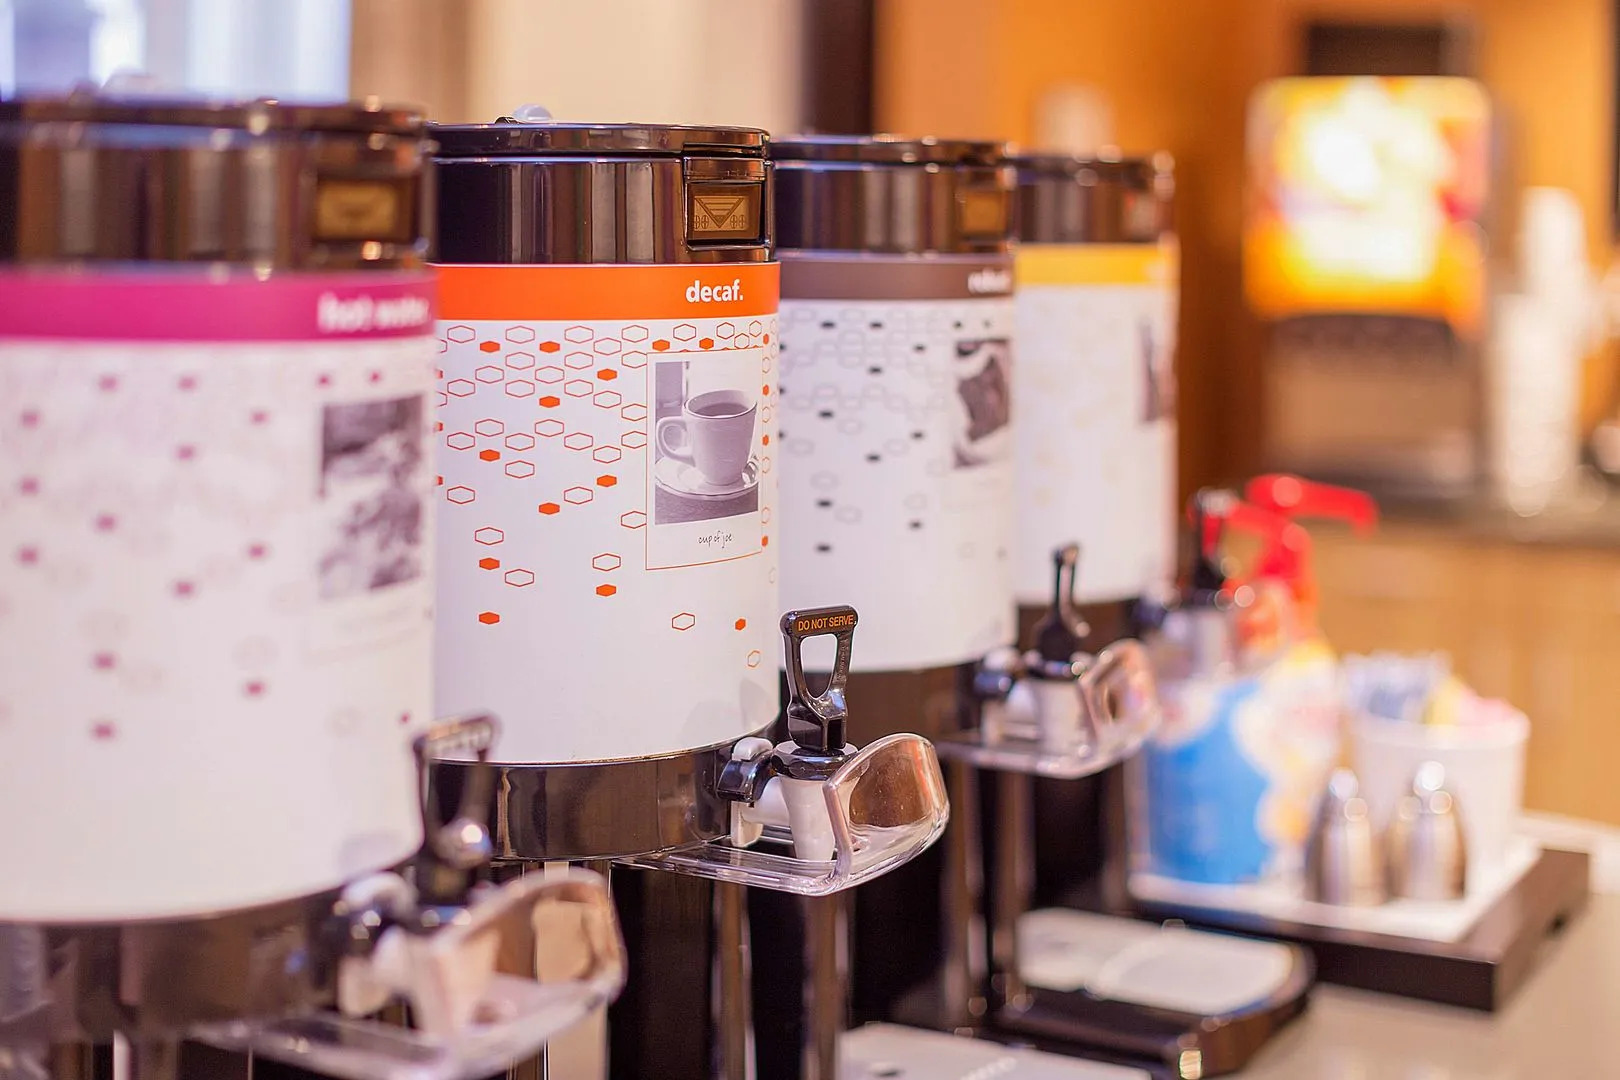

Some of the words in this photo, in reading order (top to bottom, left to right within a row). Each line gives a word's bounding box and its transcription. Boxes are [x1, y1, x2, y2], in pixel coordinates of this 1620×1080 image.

[685, 279, 744, 303] decaf.
[698, 535, 713, 548] cup
[798, 621, 810, 631] DO
[811, 618, 828, 629] NOT
[828, 614, 854, 627] SERVE
